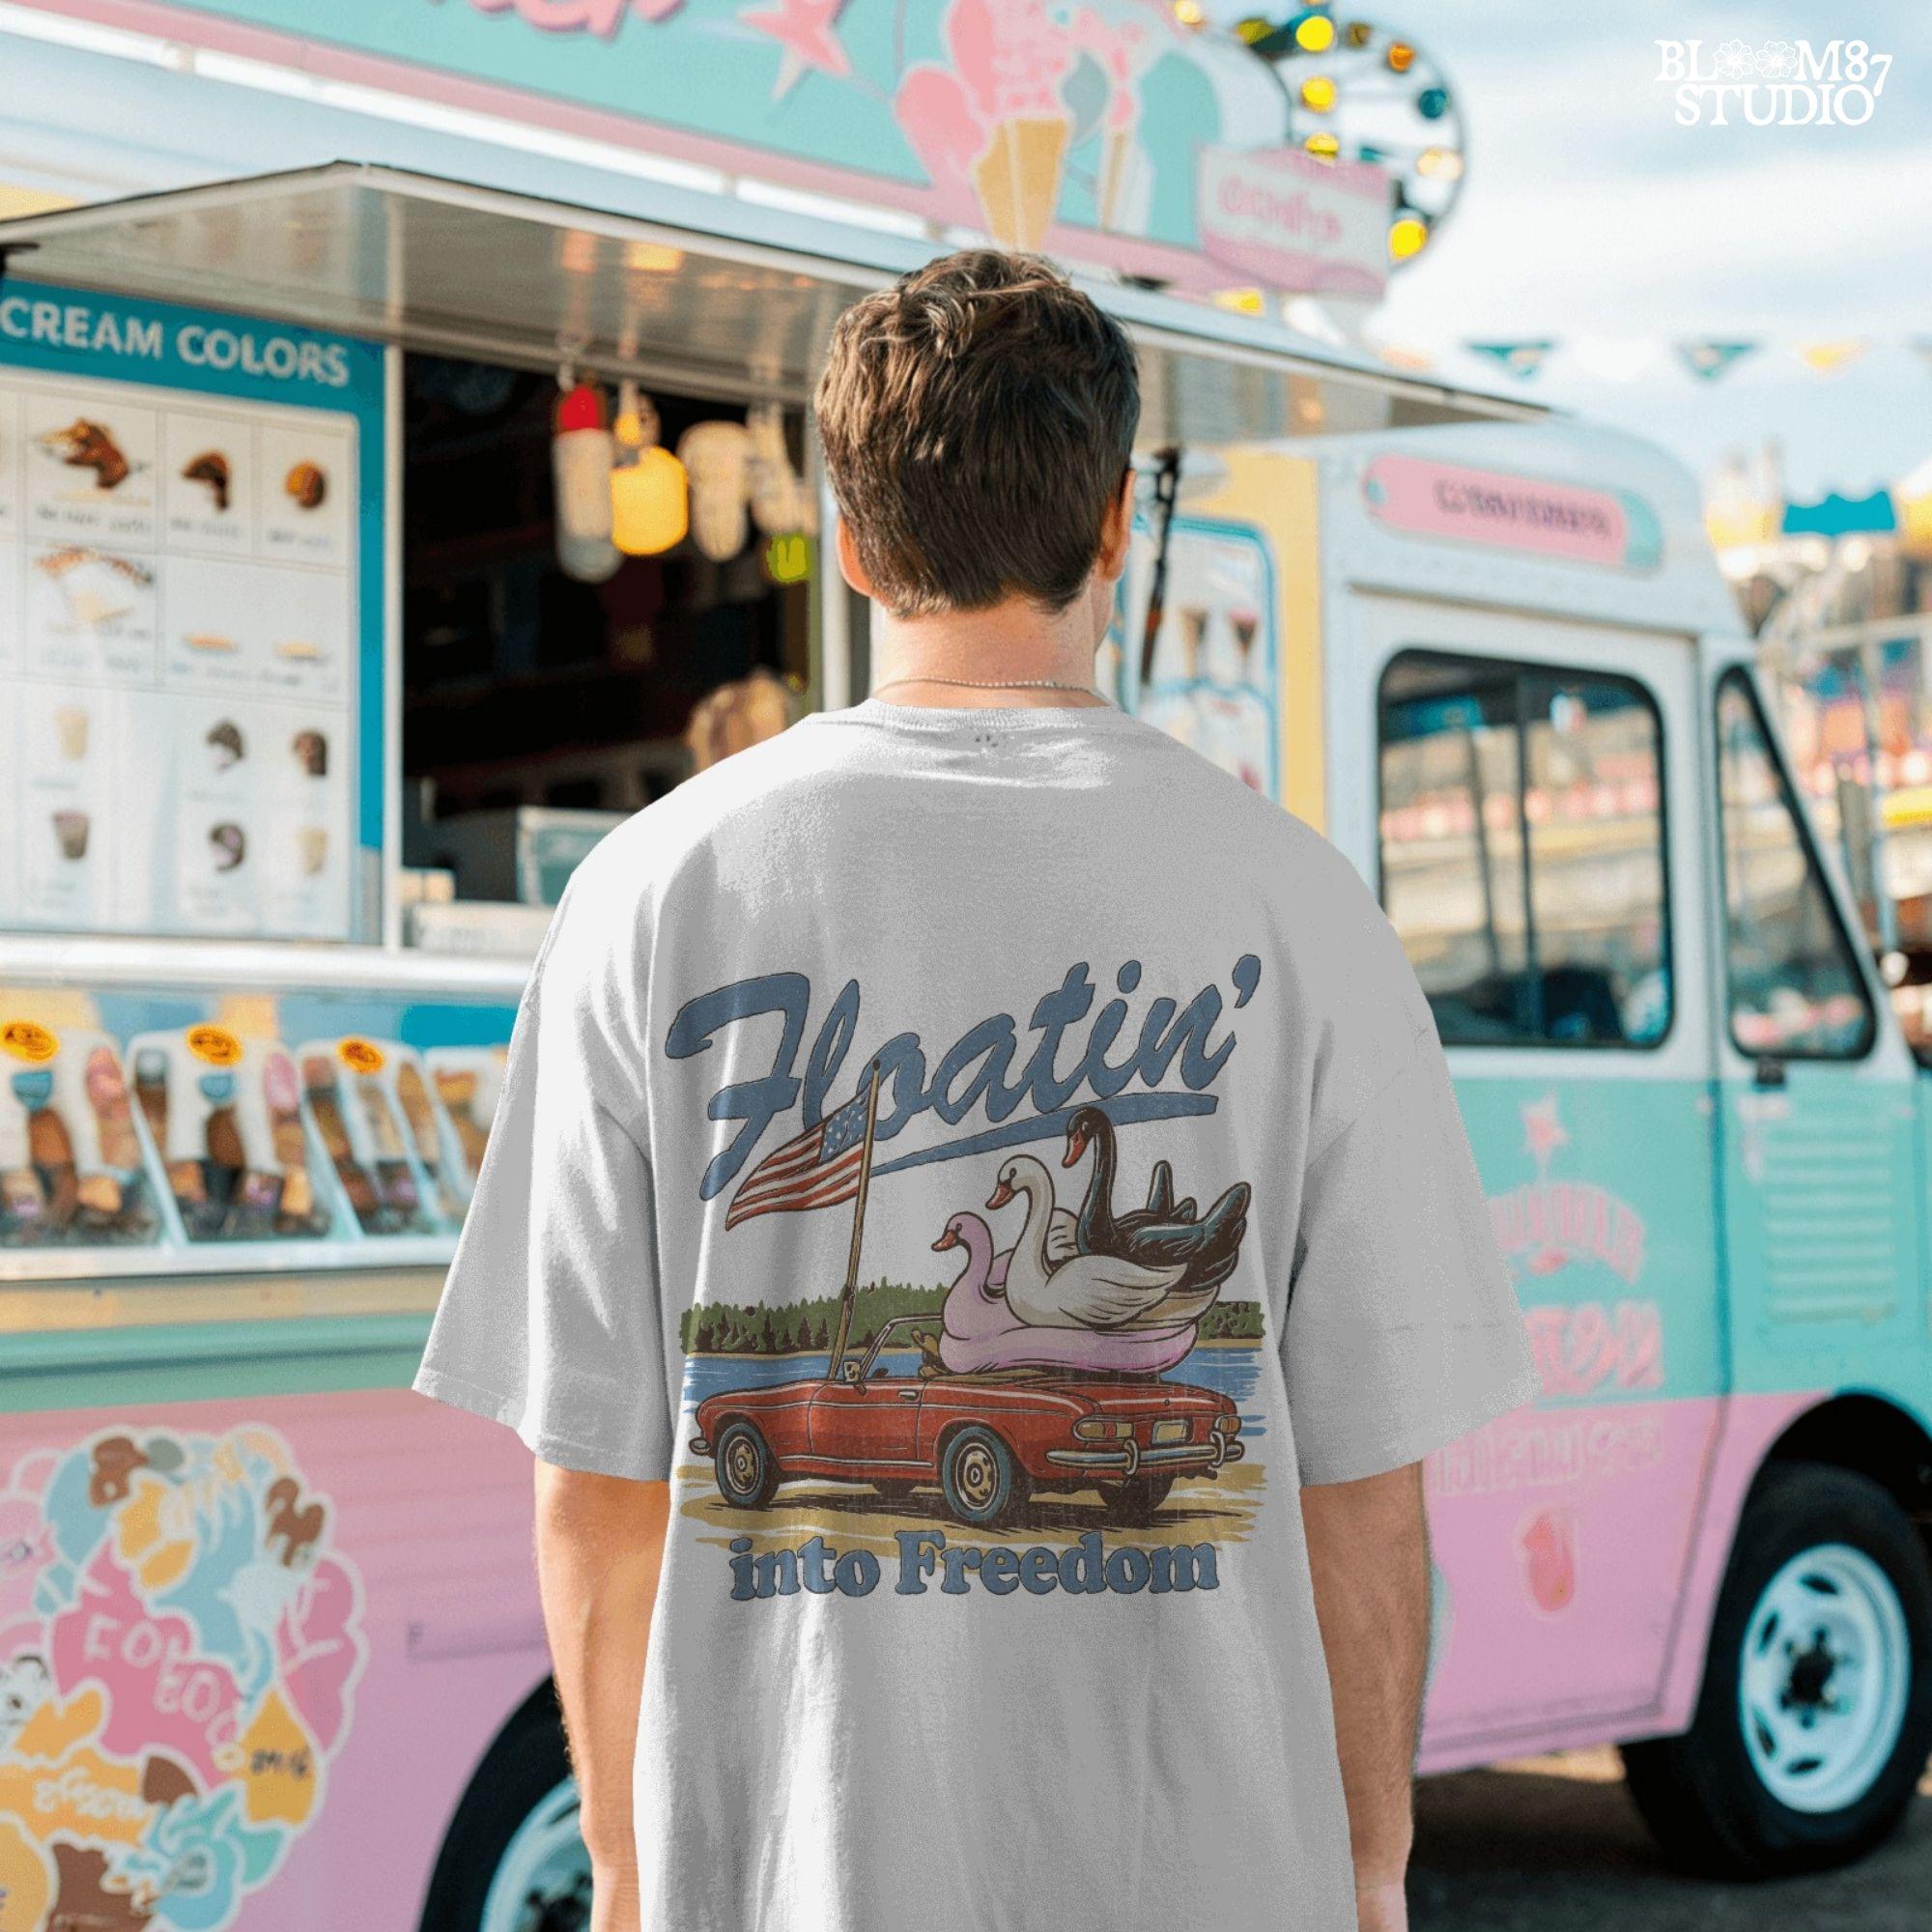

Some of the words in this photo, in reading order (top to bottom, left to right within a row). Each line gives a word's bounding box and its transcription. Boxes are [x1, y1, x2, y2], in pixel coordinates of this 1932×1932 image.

[0, 296, 163, 361] CREAM
[176, 325, 349, 387] COLORS
[665, 954, 1262, 1201] Floatin'
[729, 1536, 881, 1601] into
[895, 1529, 1221, 1595] Freedom
